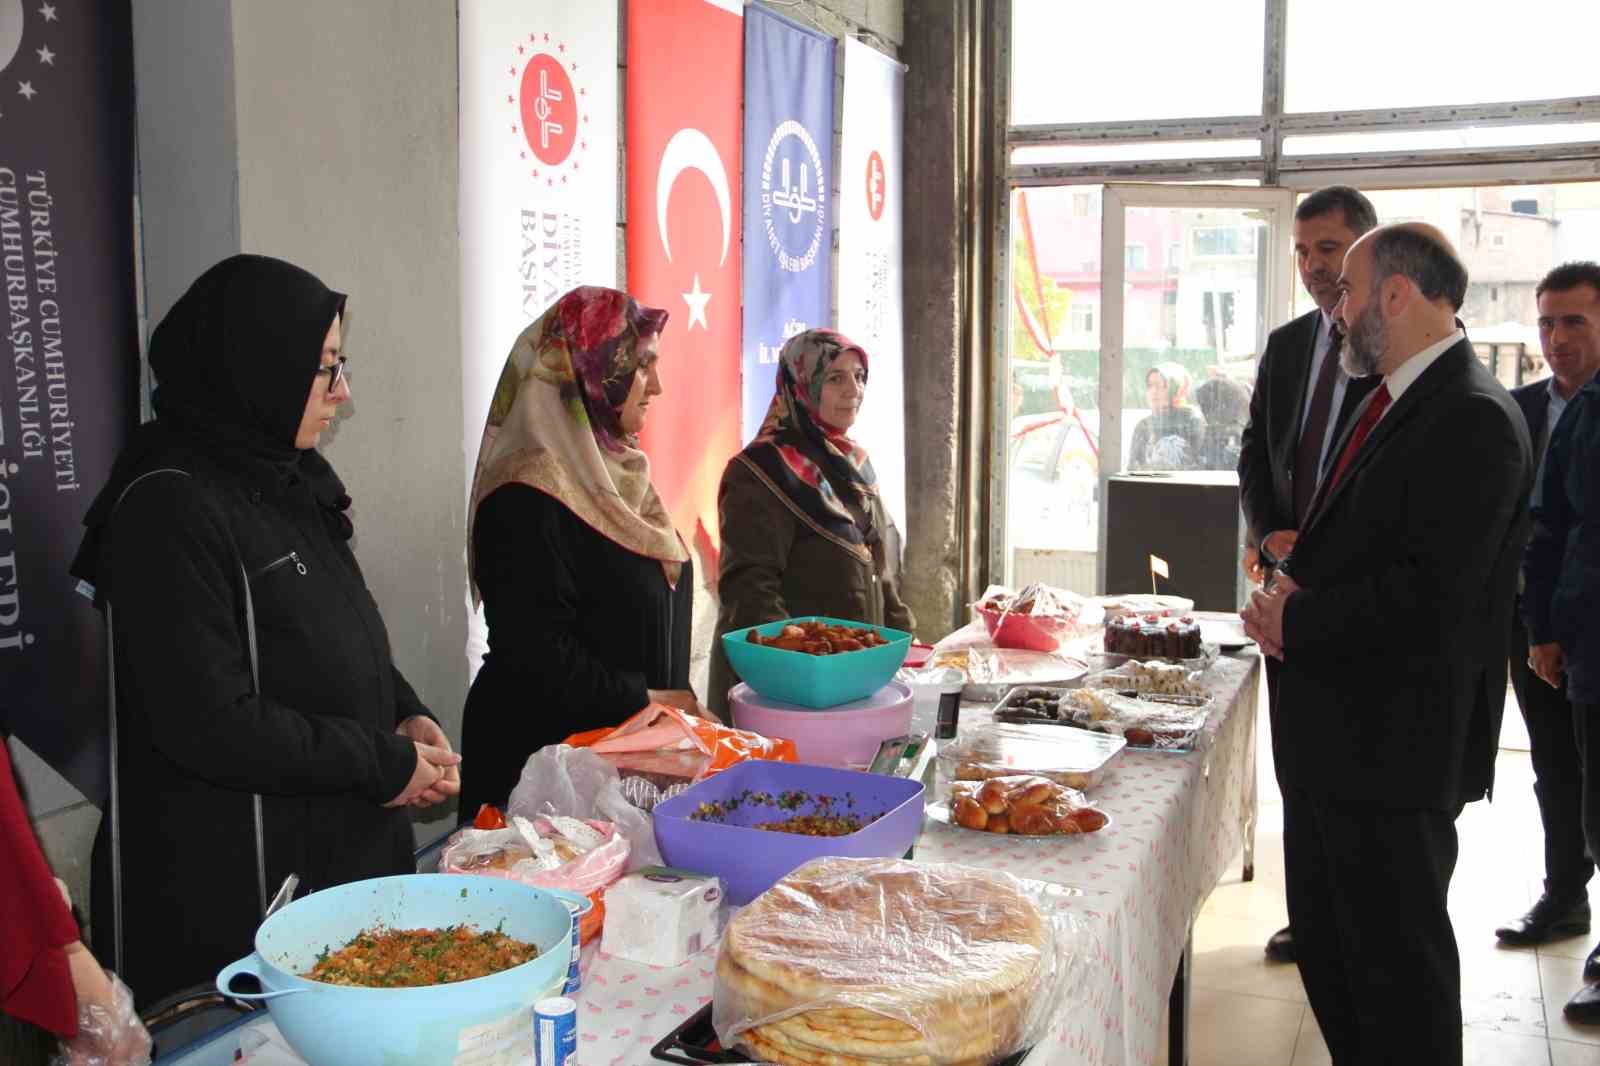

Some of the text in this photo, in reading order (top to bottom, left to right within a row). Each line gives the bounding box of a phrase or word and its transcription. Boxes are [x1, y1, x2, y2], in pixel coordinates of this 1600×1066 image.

[0, 167, 47, 458] CUMHURBAŞKANLIĞI
[26, 170, 80, 491] TÜRKİYE CUMHURİYETİ
[543, 212, 561, 303] DİYA
